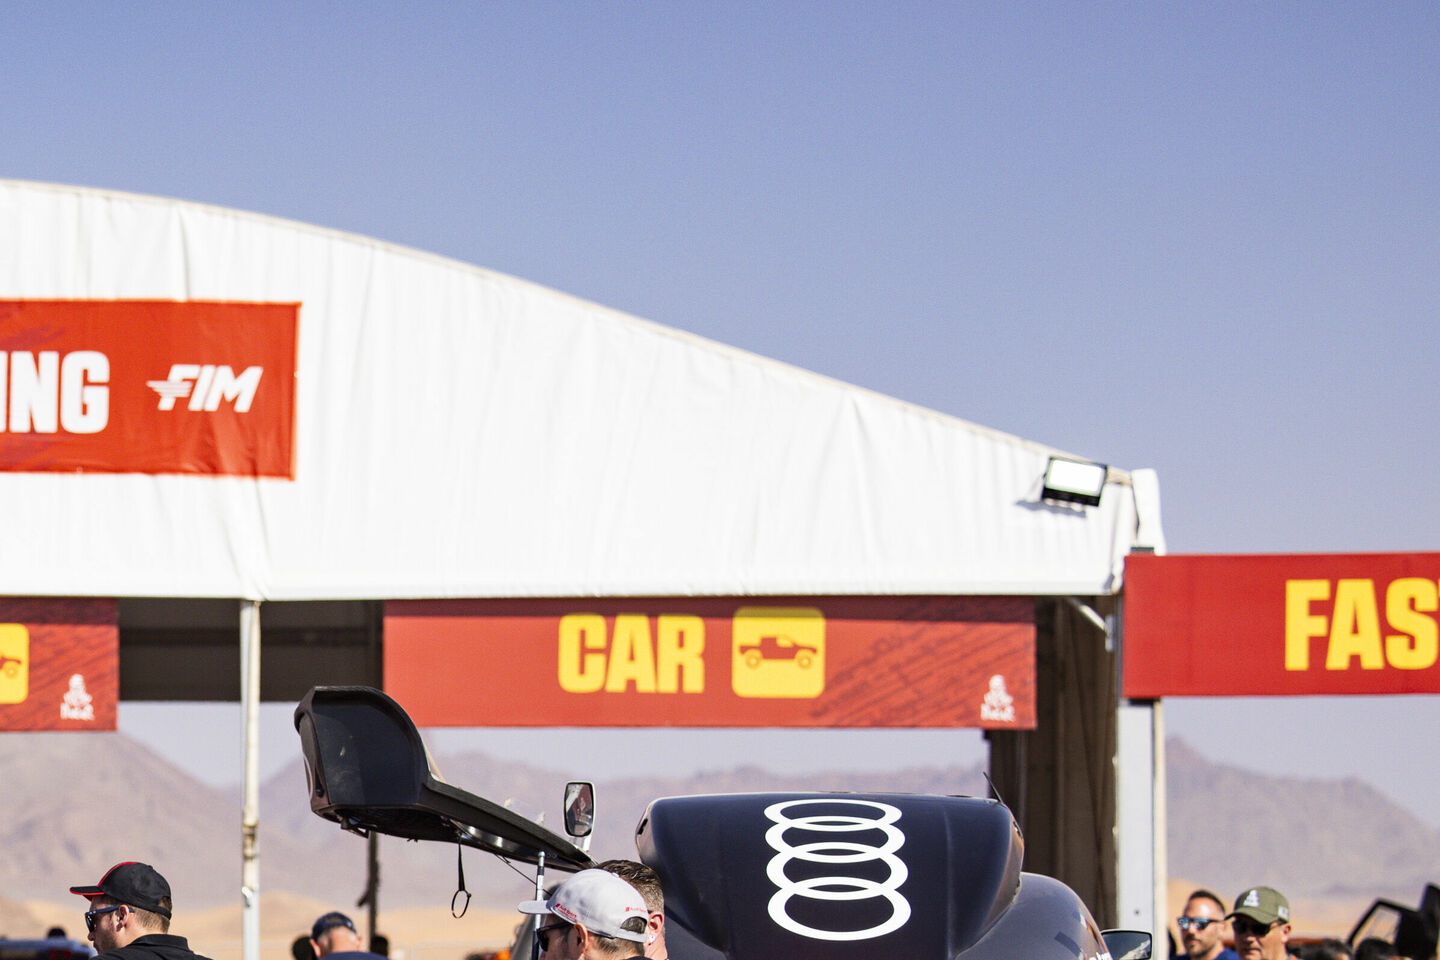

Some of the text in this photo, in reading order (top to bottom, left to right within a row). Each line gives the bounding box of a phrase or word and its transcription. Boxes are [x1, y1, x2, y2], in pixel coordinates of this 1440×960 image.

[148, 363, 264, 413] FIM
[558, 613, 706, 693] CAR
[1285, 578, 1440, 670] FAS
